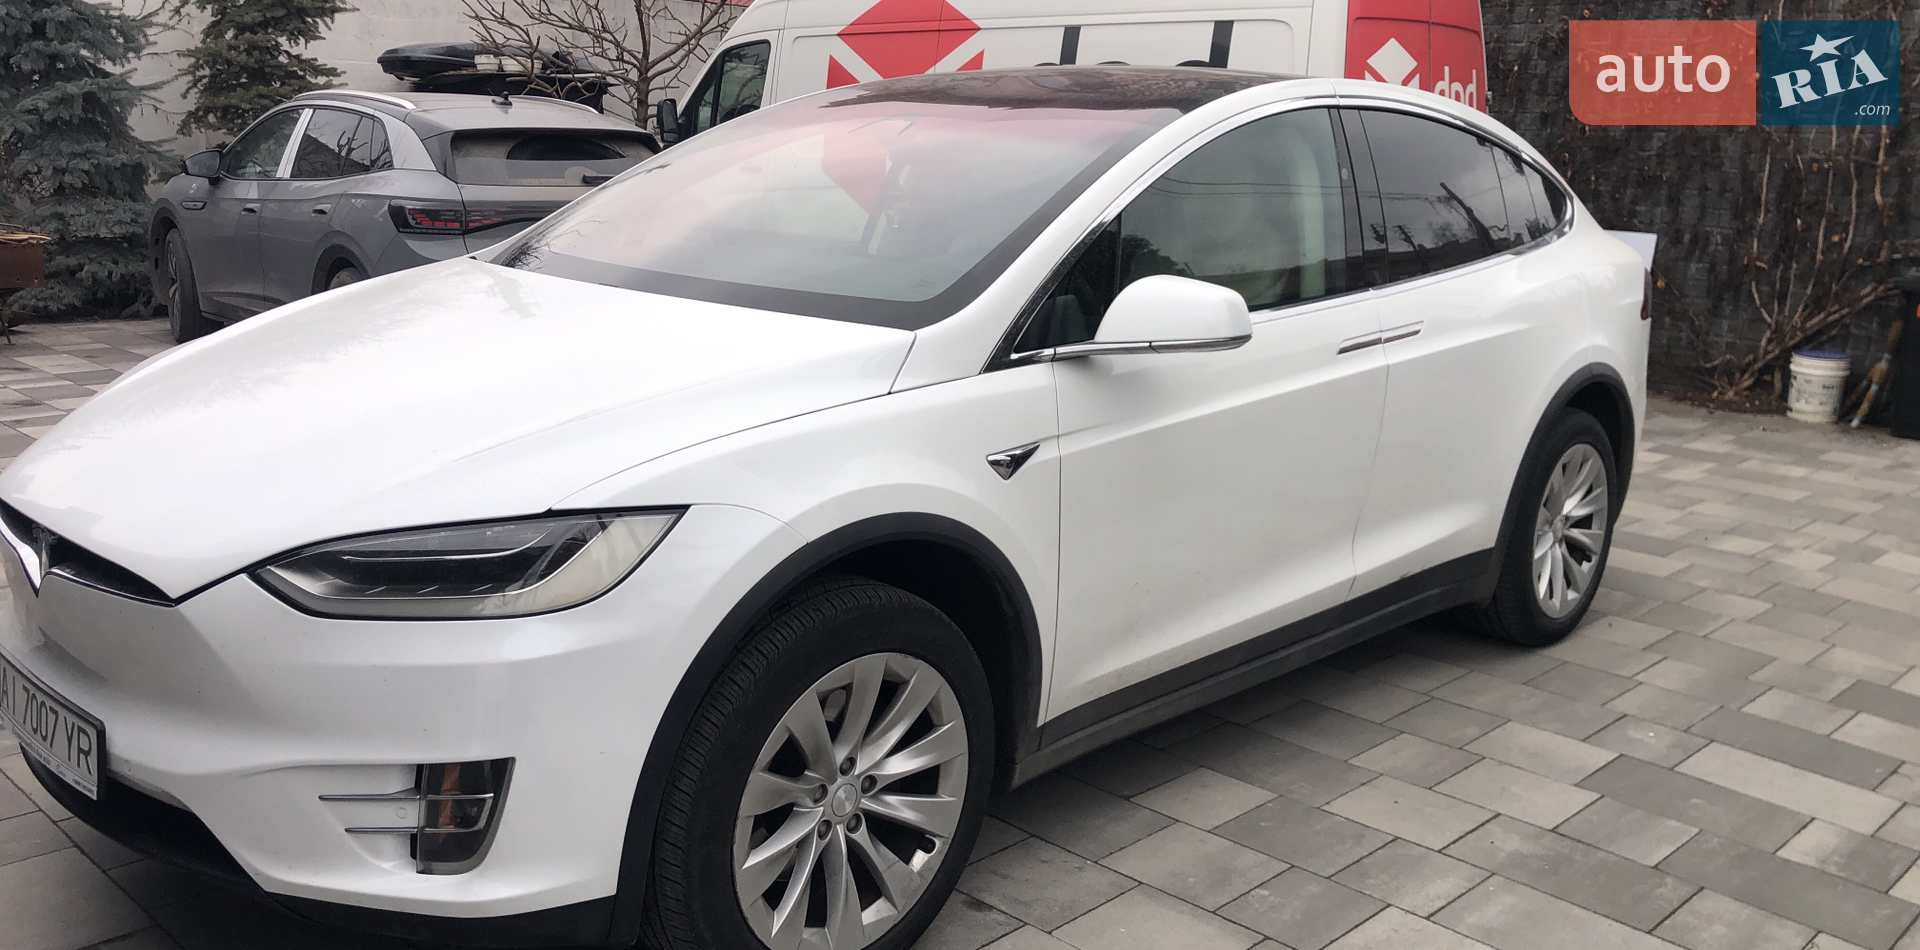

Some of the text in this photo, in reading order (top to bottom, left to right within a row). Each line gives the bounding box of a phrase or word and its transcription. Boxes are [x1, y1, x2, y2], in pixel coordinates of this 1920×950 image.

[1, 666, 16, 717] AI
[22, 683, 59, 748] 7007
[64, 715, 93, 776] YR
